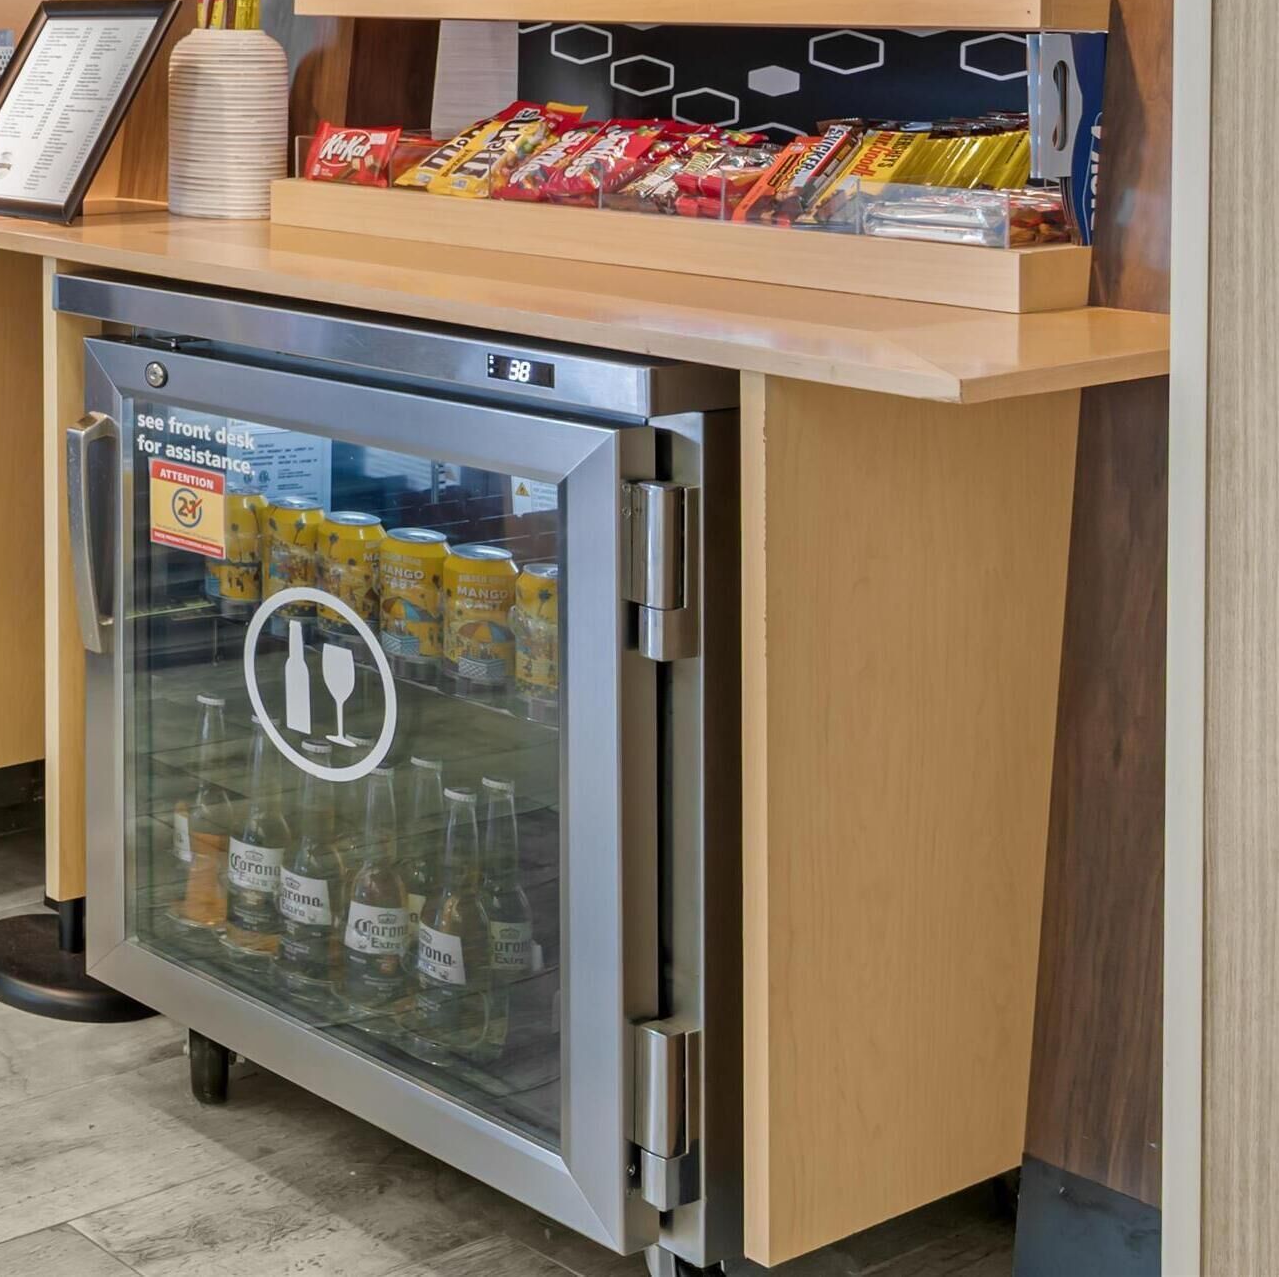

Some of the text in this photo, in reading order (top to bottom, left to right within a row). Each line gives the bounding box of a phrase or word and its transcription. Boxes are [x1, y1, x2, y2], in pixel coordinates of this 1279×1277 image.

[508, 360, 531, 382] 38
[137, 414, 255, 450] see front desk
[137, 435, 162, 454] for
[165, 442, 256, 475] assistance.
[159, 468, 214, 490] ATTENTION
[457, 586, 508, 600] MANGO
[229, 851, 281, 876] Corona
[371, 936, 401, 951] Extra
[421, 939, 456, 964] rona
